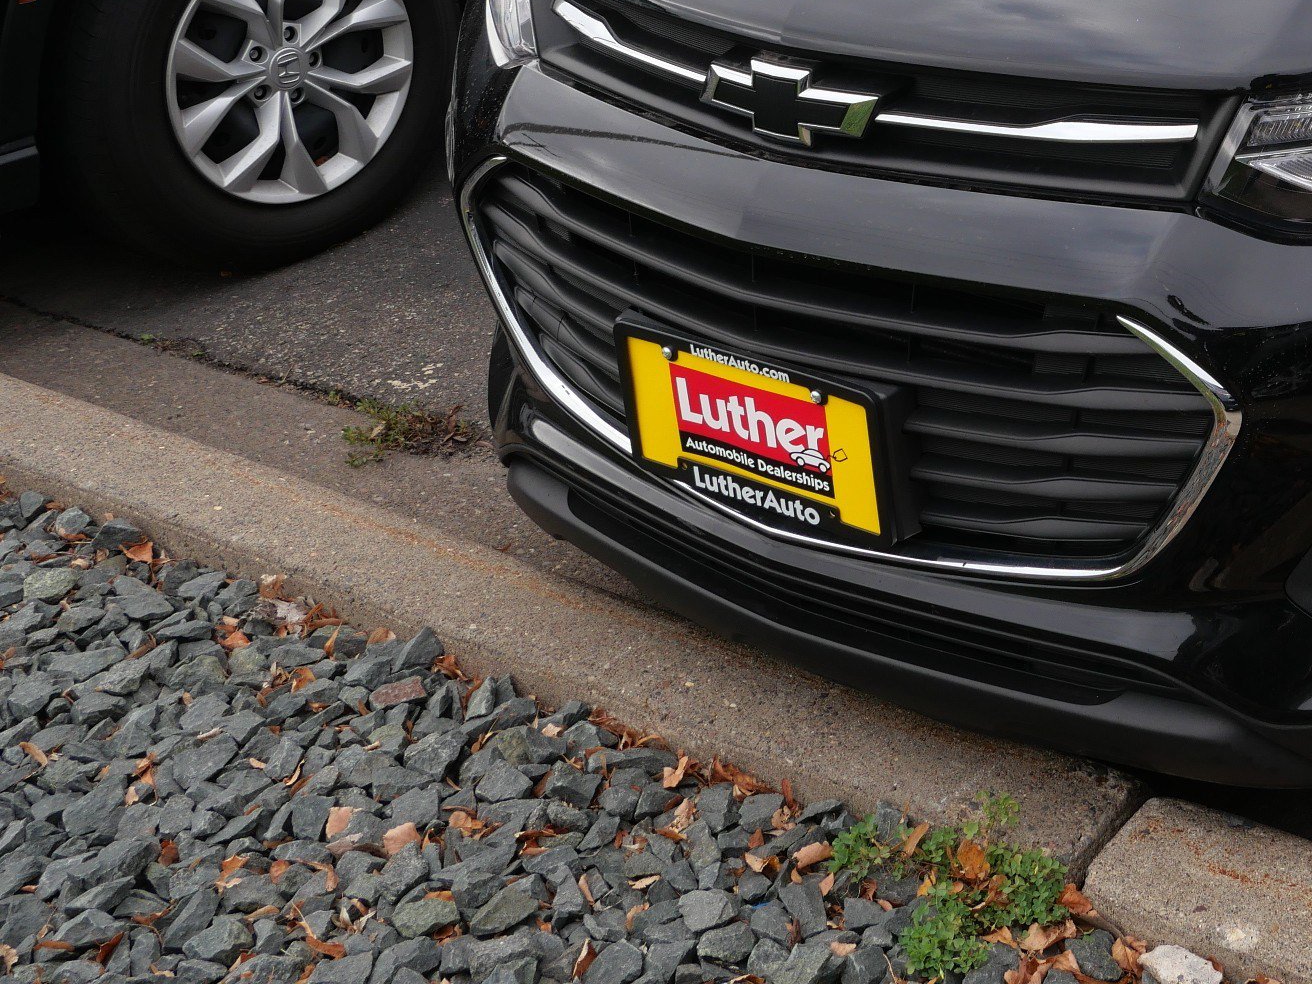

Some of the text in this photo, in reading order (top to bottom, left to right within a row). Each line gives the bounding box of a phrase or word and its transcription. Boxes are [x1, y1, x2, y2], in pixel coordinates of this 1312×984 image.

[689, 344, 790, 384] LutherAuto.com
[675, 376, 824, 452] Luther
[685, 436, 830, 492] Automobile Dealerships
[693, 466, 821, 525] LutherAuto
